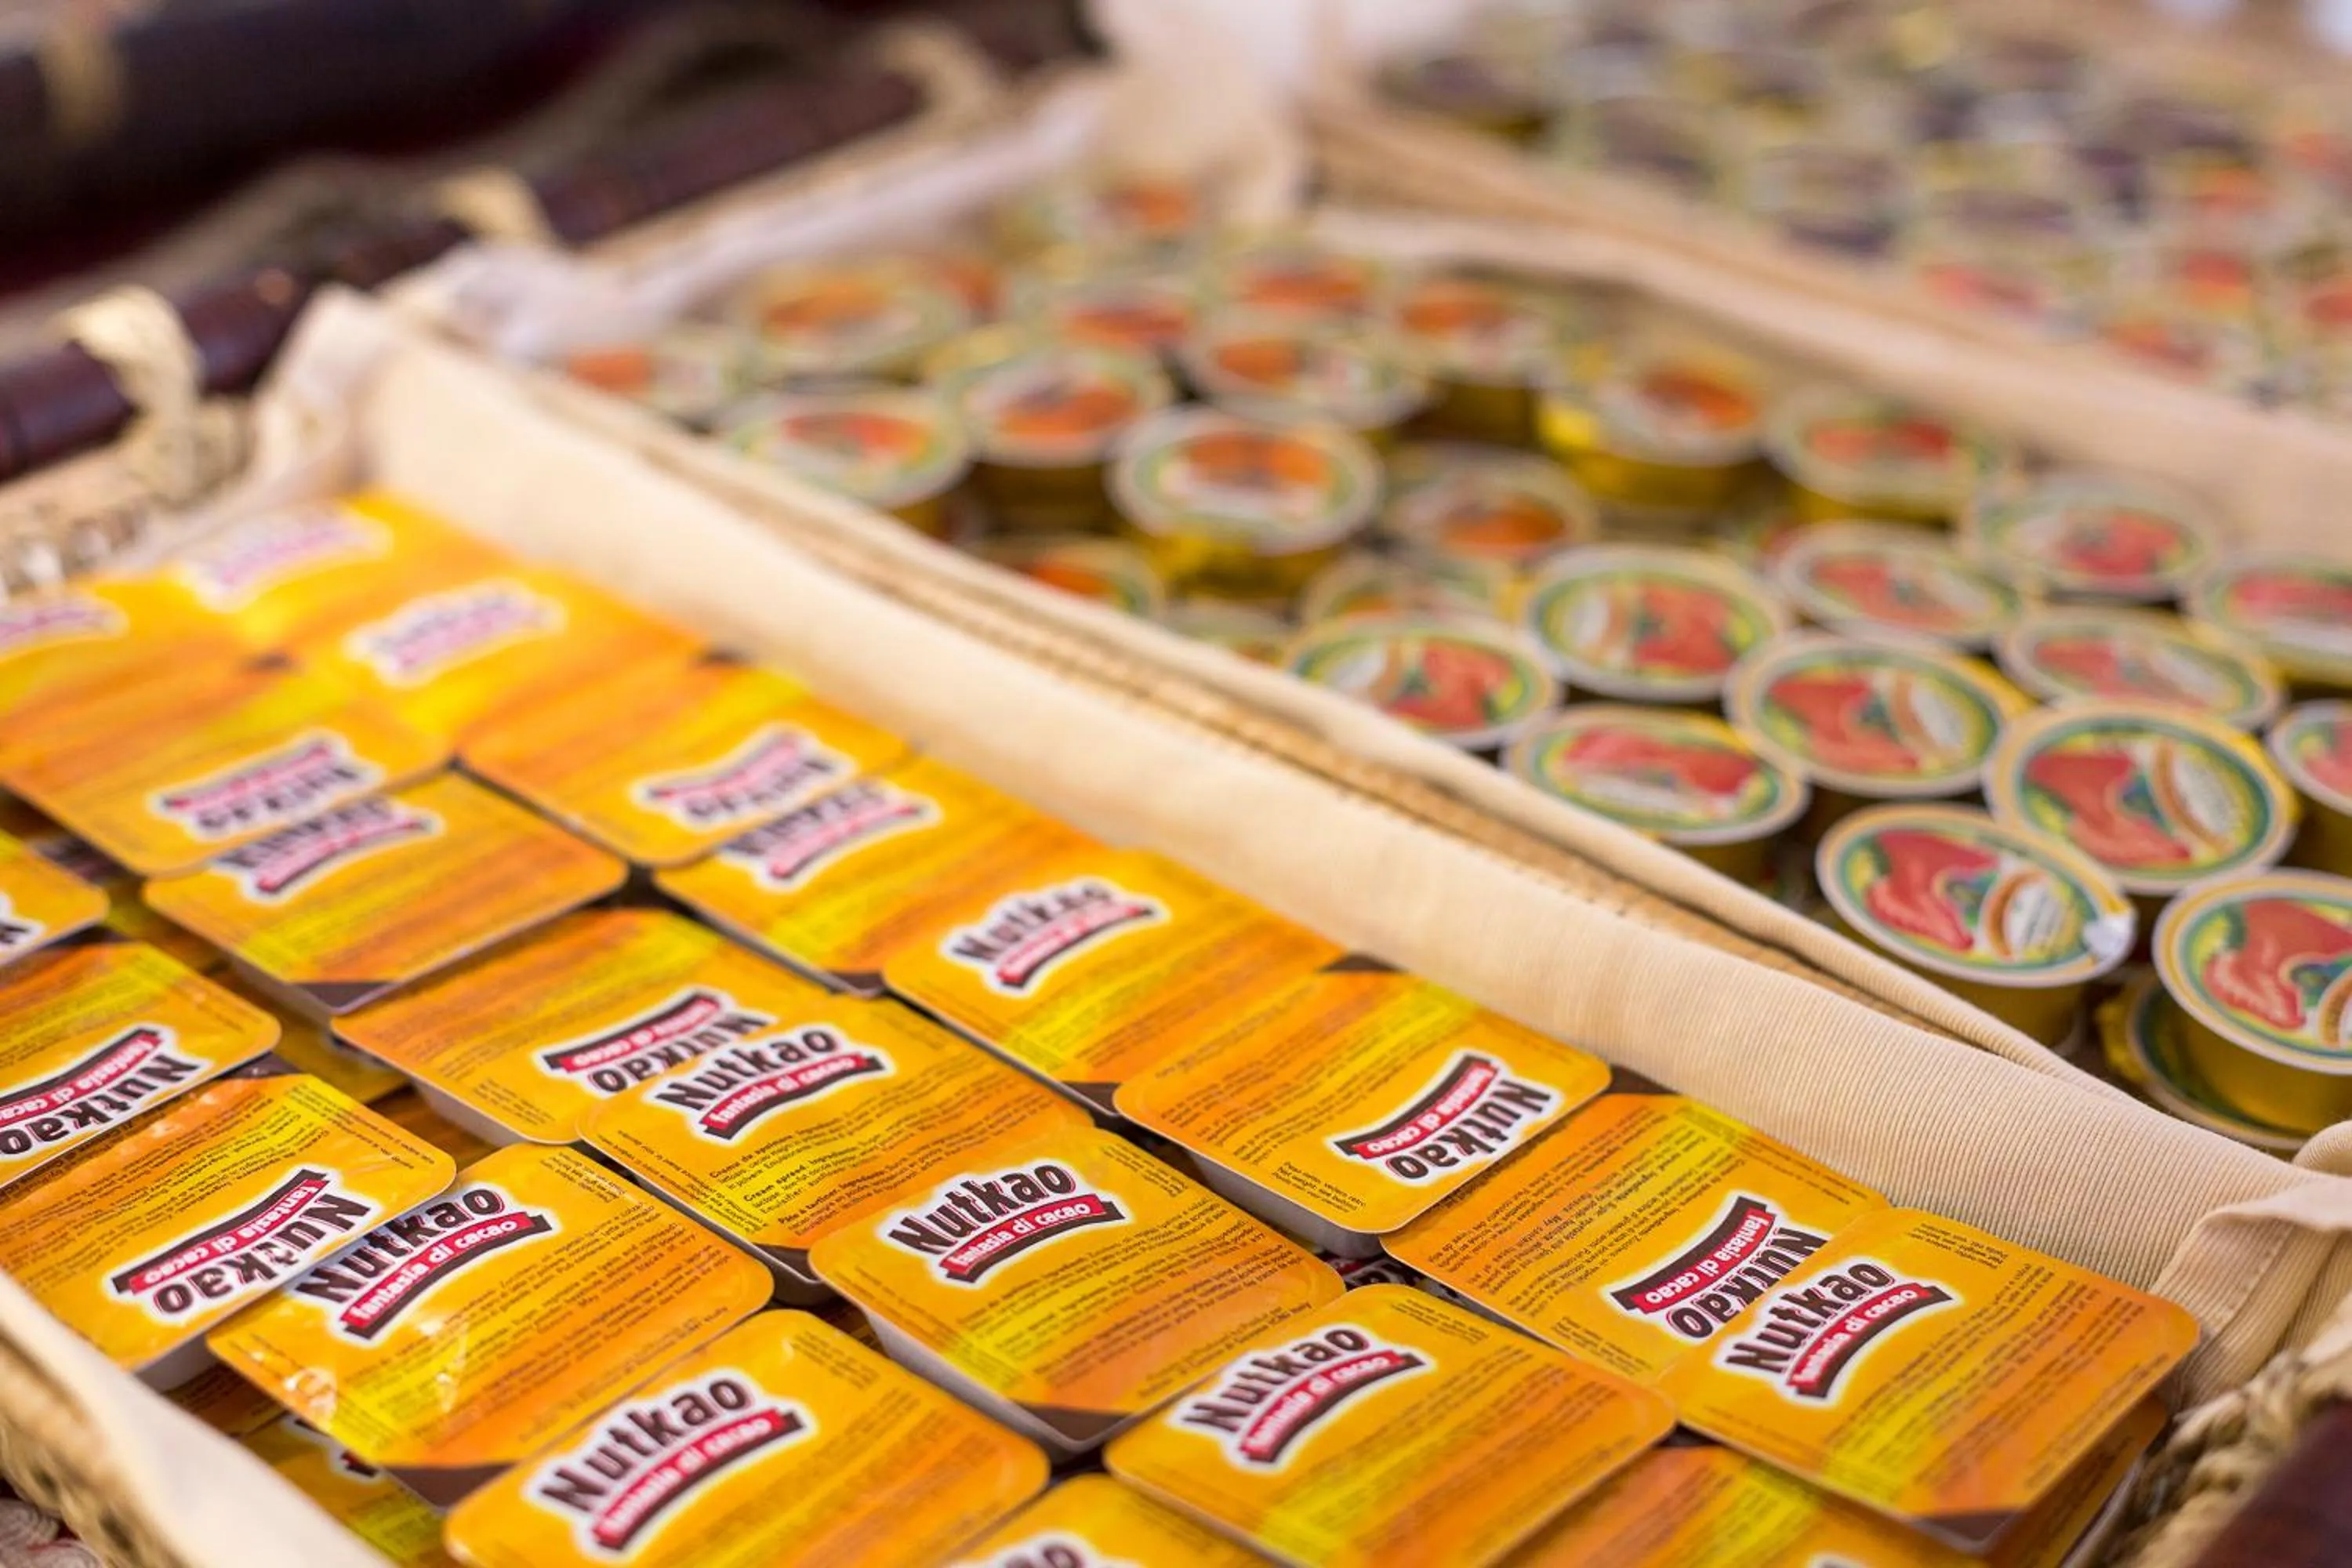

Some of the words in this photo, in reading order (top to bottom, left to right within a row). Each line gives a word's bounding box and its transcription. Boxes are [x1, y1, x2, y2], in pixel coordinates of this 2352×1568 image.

[0, 1052, 201, 1155] Nutkao
[656, 1029, 840, 1111] Nutkao
[710, 1083, 782, 1123] fantasia
[775, 1072, 798, 1091] di
[798, 1057, 856, 1083] cacao
[1367, 1125, 1422, 1153] cacao
[1385, 1079, 1551, 1179] Nutkao
[1417, 1112, 1442, 1131] di
[214, 1236, 238, 1254] di
[238, 1185, 321, 1240] fantasia
[295, 1189, 506, 1304] Nutkao
[887, 1164, 1077, 1255] Nutkao
[950, 1229, 1015, 1265] fantasia
[1013, 1217, 1033, 1236] di
[1033, 1202, 1091, 1225] cacao
[1715, 1214, 1770, 1265] fantasia
[143, 1247, 210, 1284] cacao
[154, 1193, 371, 1314] Nutkao
[352, 1261, 430, 1320] fantasia
[427, 1240, 455, 1263] di
[454, 1220, 519, 1249] cacao
[1645, 1271, 1702, 1305] cacao
[1666, 1226, 1830, 1338] Nutkao
[1697, 1258, 1719, 1277] di
[1726, 1263, 1896, 1374] Nutkao
[1845, 1313, 1871, 1333] di
[1864, 1288, 1918, 1319] cacao
[1182, 1329, 1370, 1432] Nutkao
[542, 1379, 756, 1513] Nutkao
